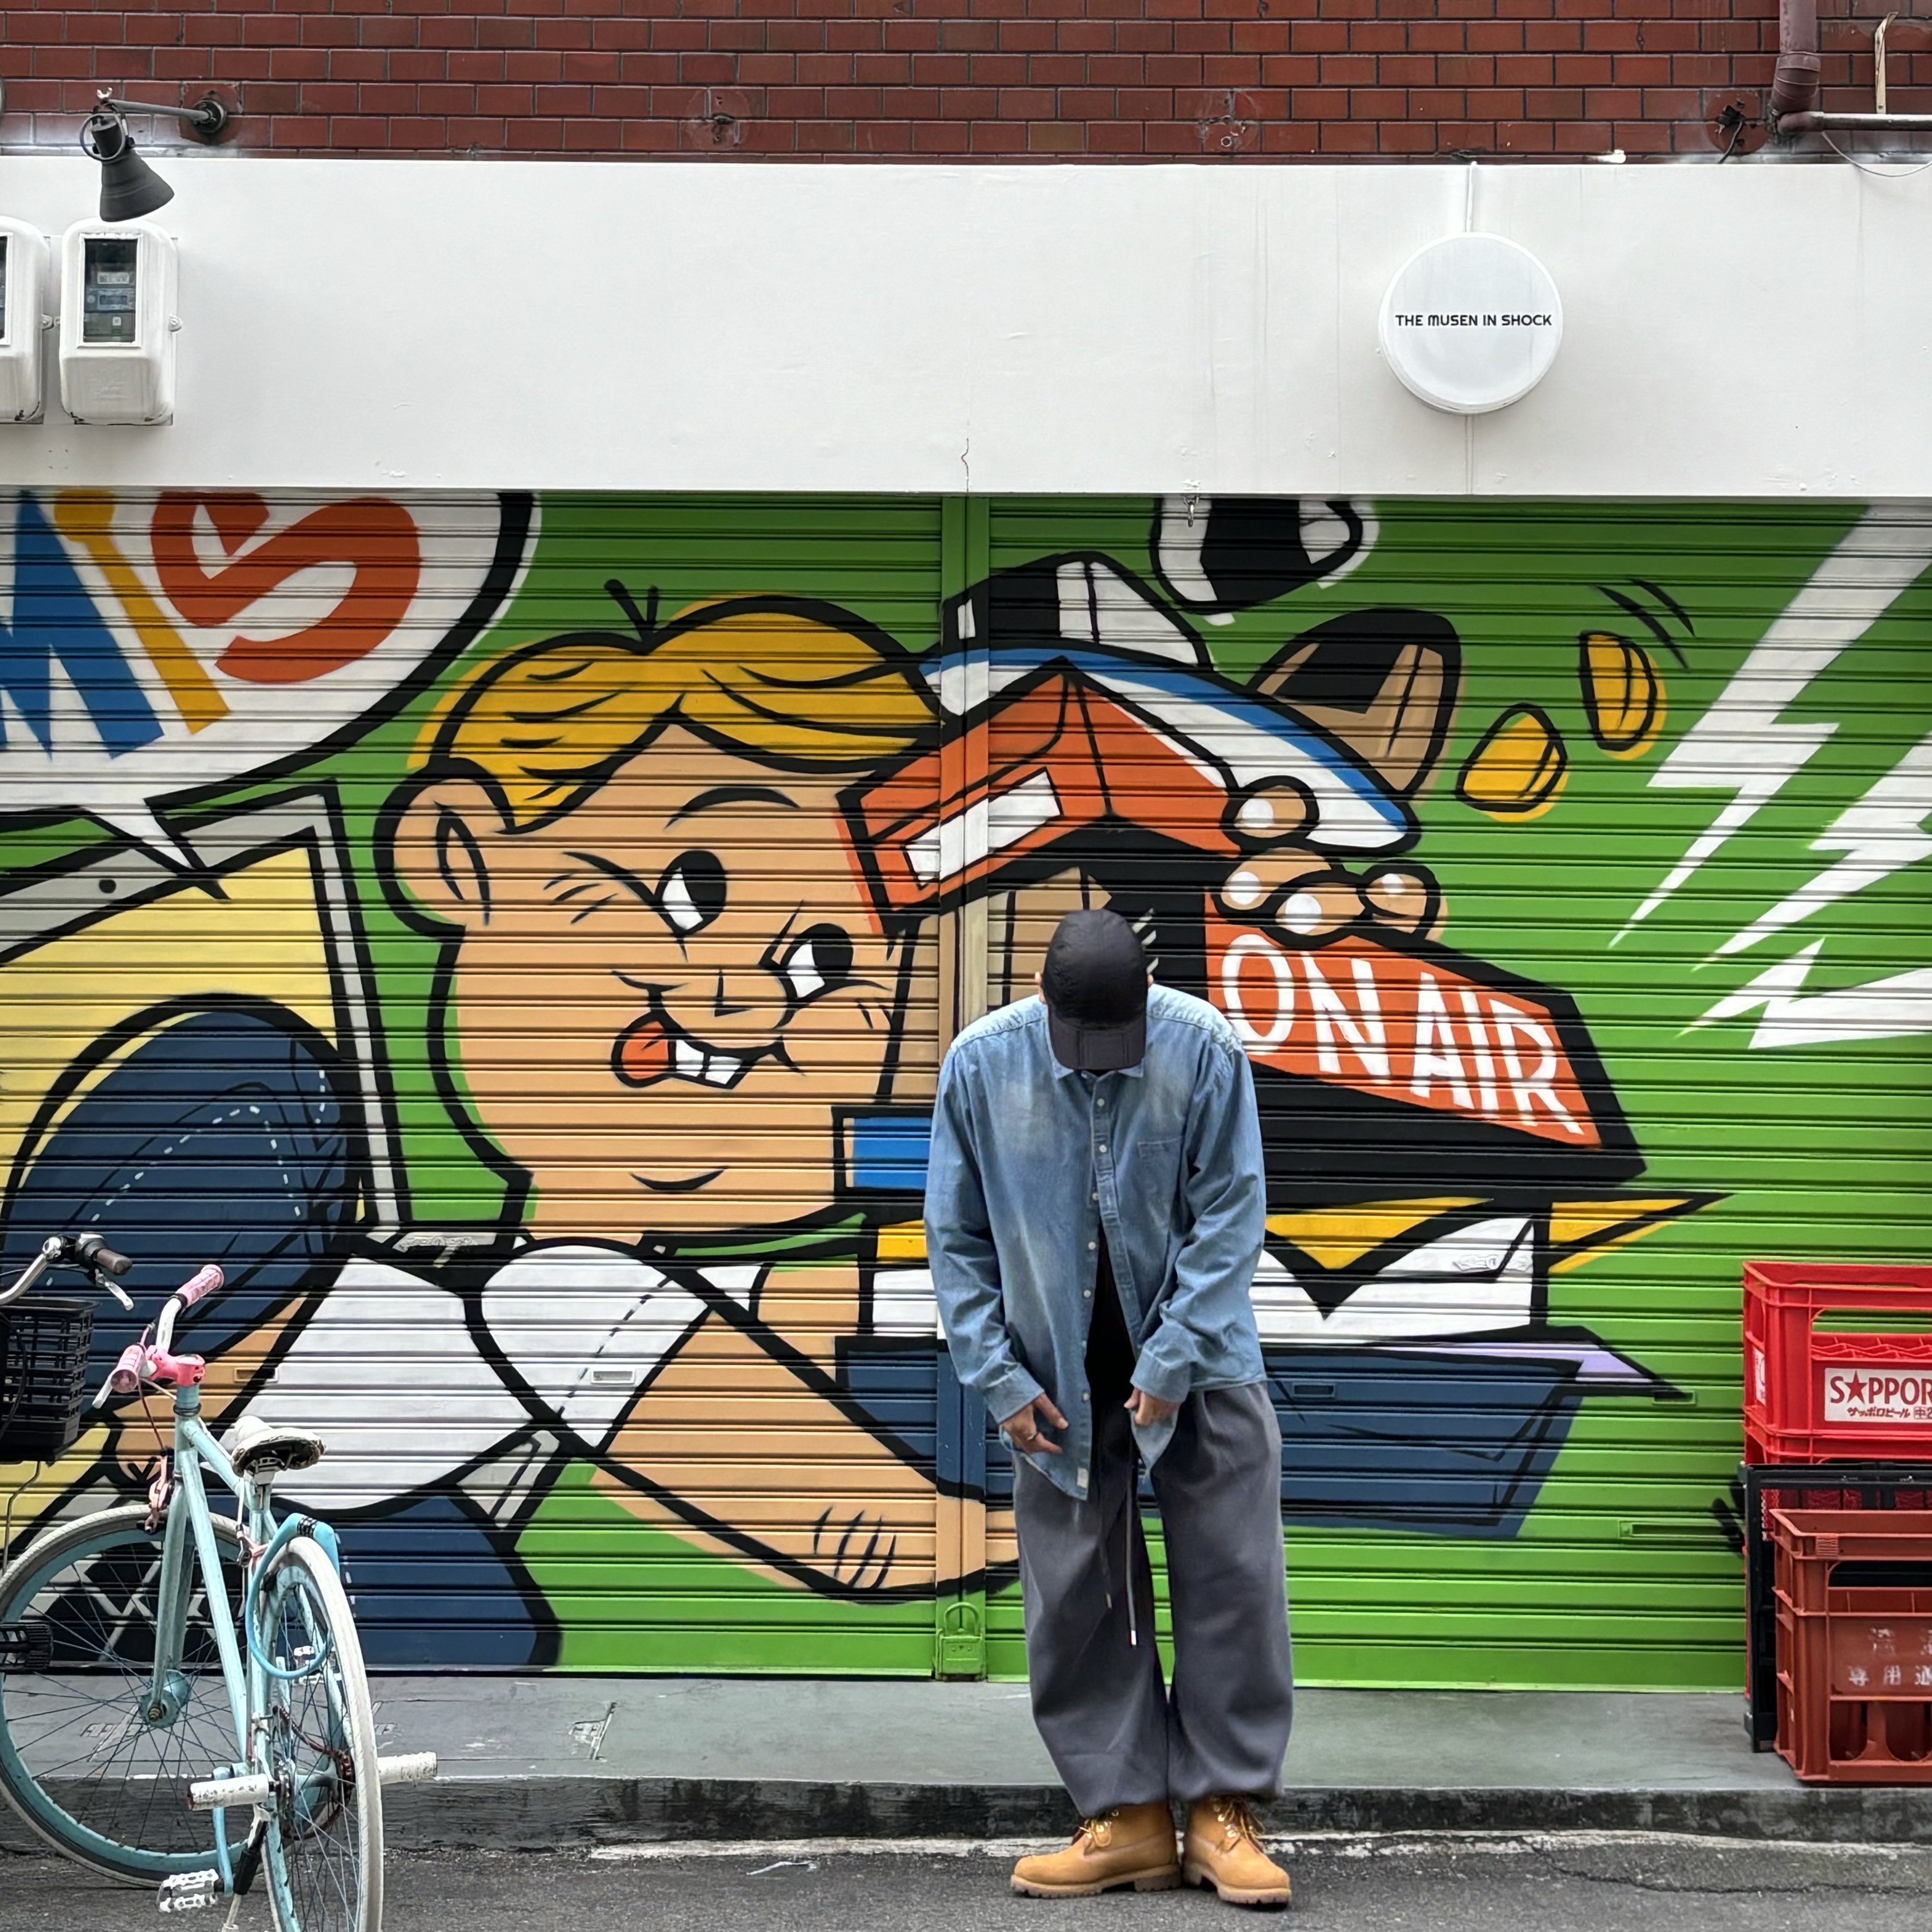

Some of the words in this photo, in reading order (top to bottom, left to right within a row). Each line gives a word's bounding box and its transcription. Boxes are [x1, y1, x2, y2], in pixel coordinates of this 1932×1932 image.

[1395, 314, 1423, 326] THE
[1428, 314, 1478, 326] MUSEN
[1483, 314, 1497, 326] IN
[1501, 314, 1552, 326] SHOCK
[1222, 934, 1391, 1084] ON
[1410, 971, 1585, 1135] AIR
[1847, 1406, 1911, 1418] サッポロビール
